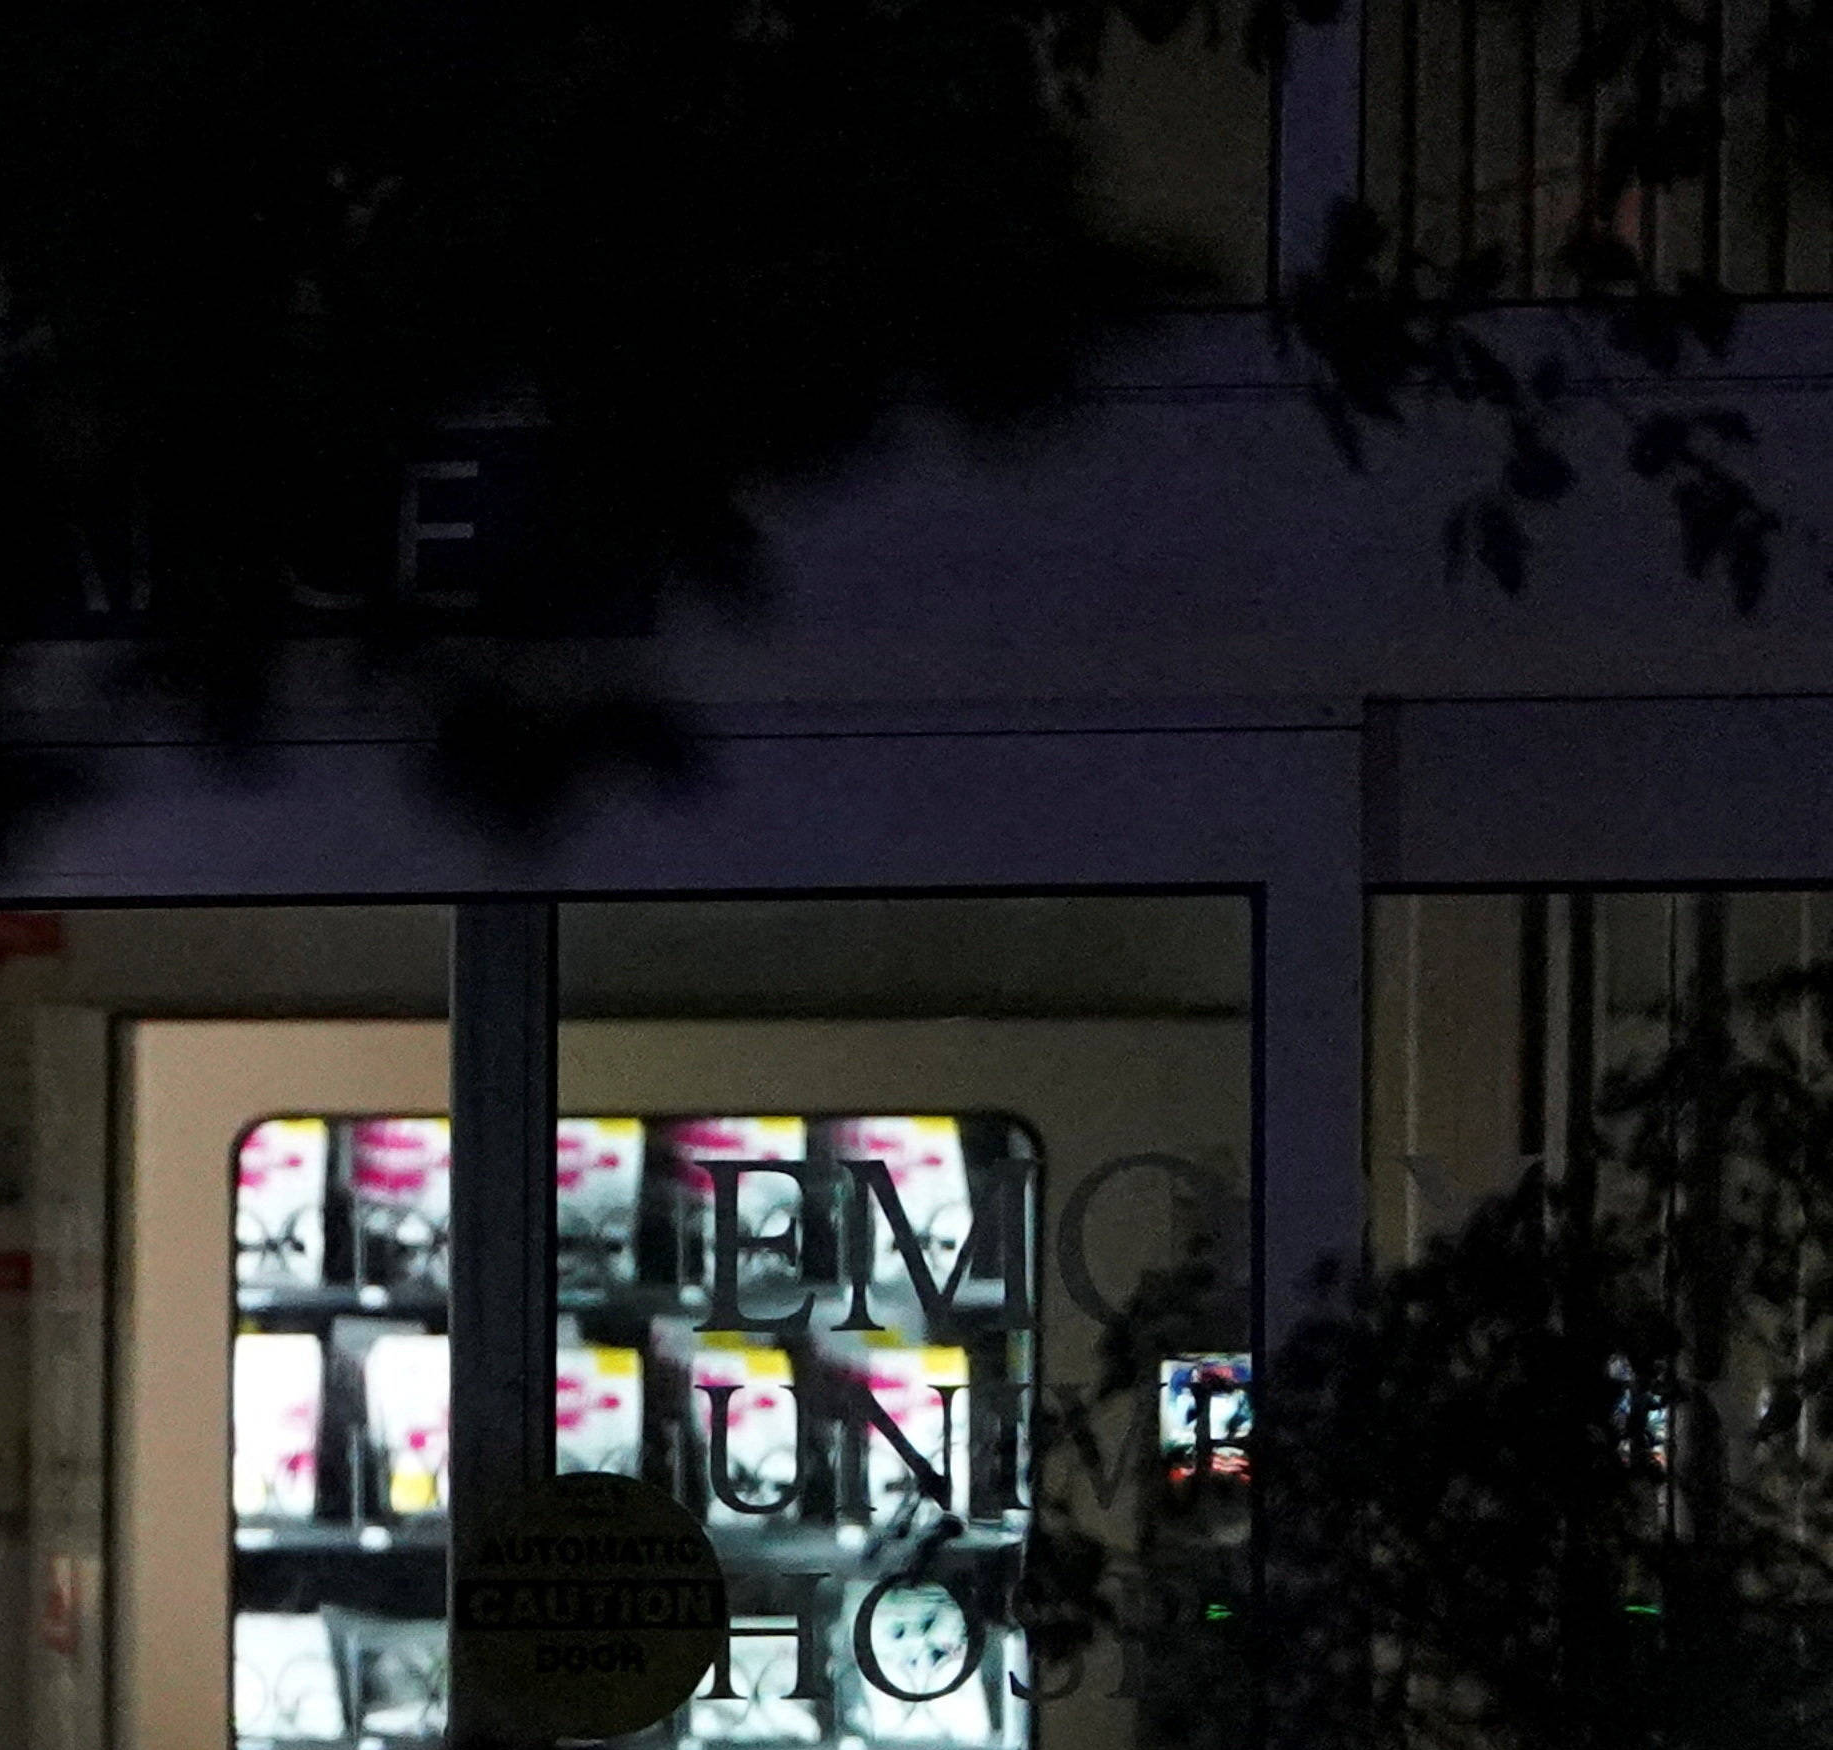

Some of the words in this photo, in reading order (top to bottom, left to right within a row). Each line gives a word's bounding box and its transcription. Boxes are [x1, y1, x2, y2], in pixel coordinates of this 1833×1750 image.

[479, 1536, 703, 1565] AUTOMATIC
[468, 1586, 714, 1625] CAUTION
[536, 1644, 646, 1674] DOOR
